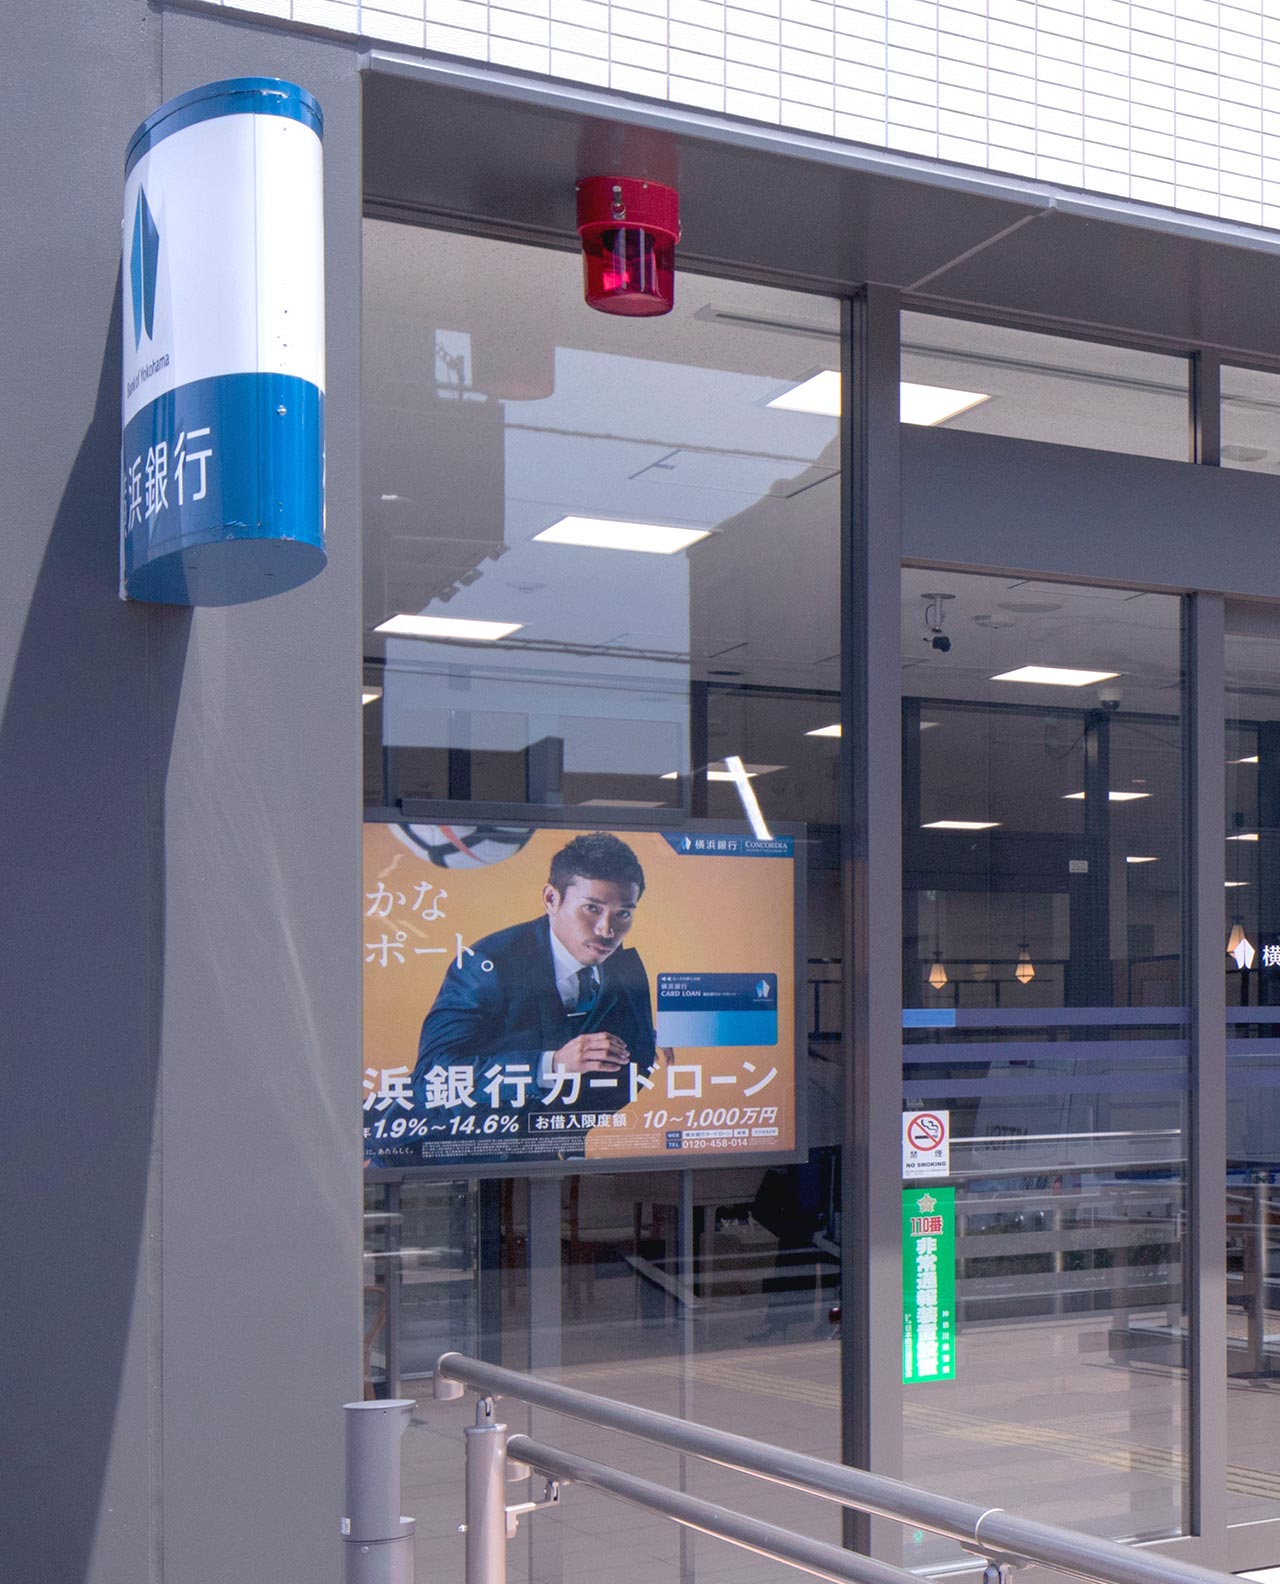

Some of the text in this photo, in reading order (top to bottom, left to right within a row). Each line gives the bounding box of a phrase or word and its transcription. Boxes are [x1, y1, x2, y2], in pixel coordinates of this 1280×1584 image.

[140, 354, 170, 383] Yokohama
[123, 427, 213, 540] 浜銀行
[694, 840, 738, 851] 横浜銀行
[745, 840, 788, 850] CONCORDIA
[366, 881, 449, 921] かな
[366, 932, 495, 973] ポート。
[535, 1113, 628, 1130] お借入限度額
[682, 1138, 748, 1149] 0120-458-014
[917, 1160, 947, 1168] SMOKING
[910, 1214, 943, 1234] 110番
